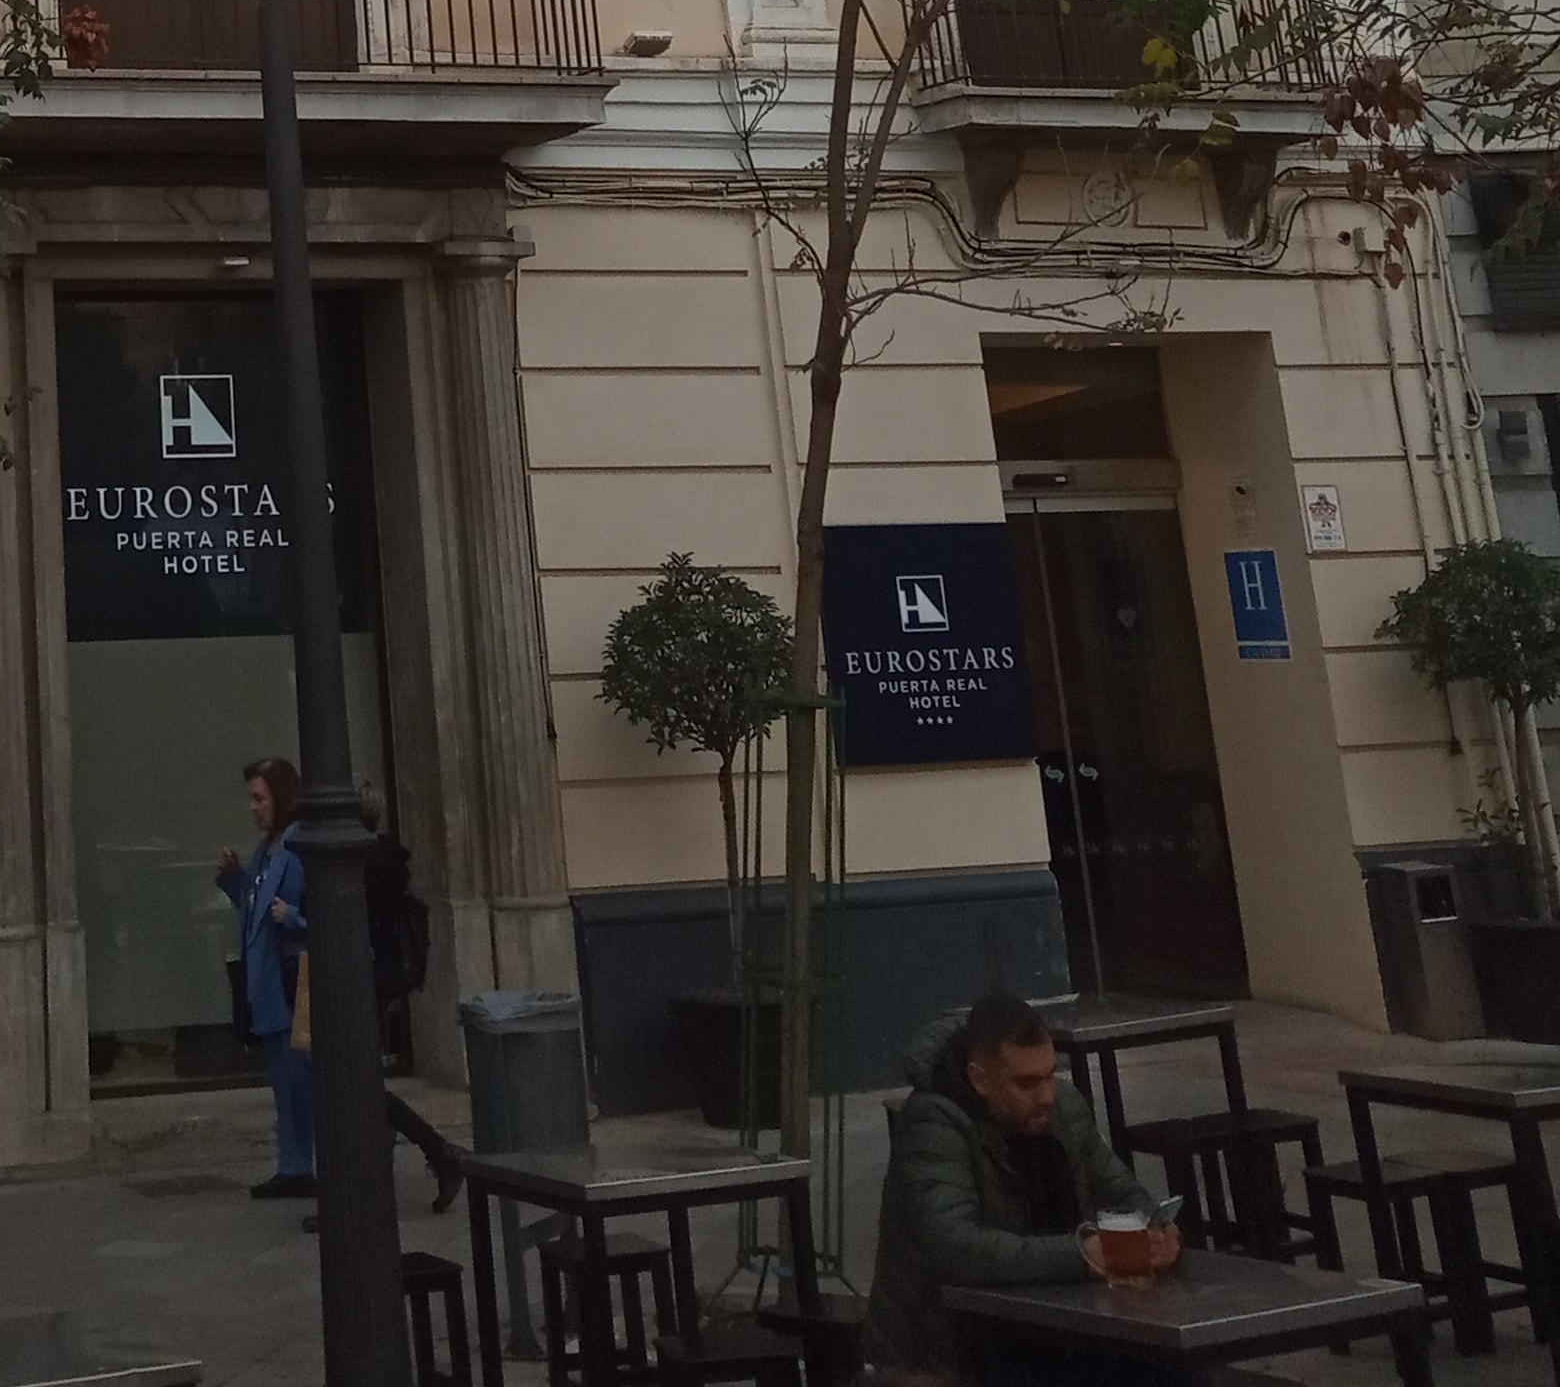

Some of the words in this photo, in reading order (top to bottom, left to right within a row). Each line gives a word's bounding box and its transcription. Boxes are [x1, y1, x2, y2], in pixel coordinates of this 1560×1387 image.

[67, 482, 335, 521] EUROSTA
[116, 530, 214, 551] PUERTA
[226, 528, 290, 548] REAL
[163, 554, 245, 575] HOTEL
[1238, 560, 1268, 611] H
[845, 646, 1014, 675] EUROSTARS
[878, 679, 940, 694] PUERTA
[946, 677, 988, 692] REAL
[909, 695, 961, 709] HOTEL
